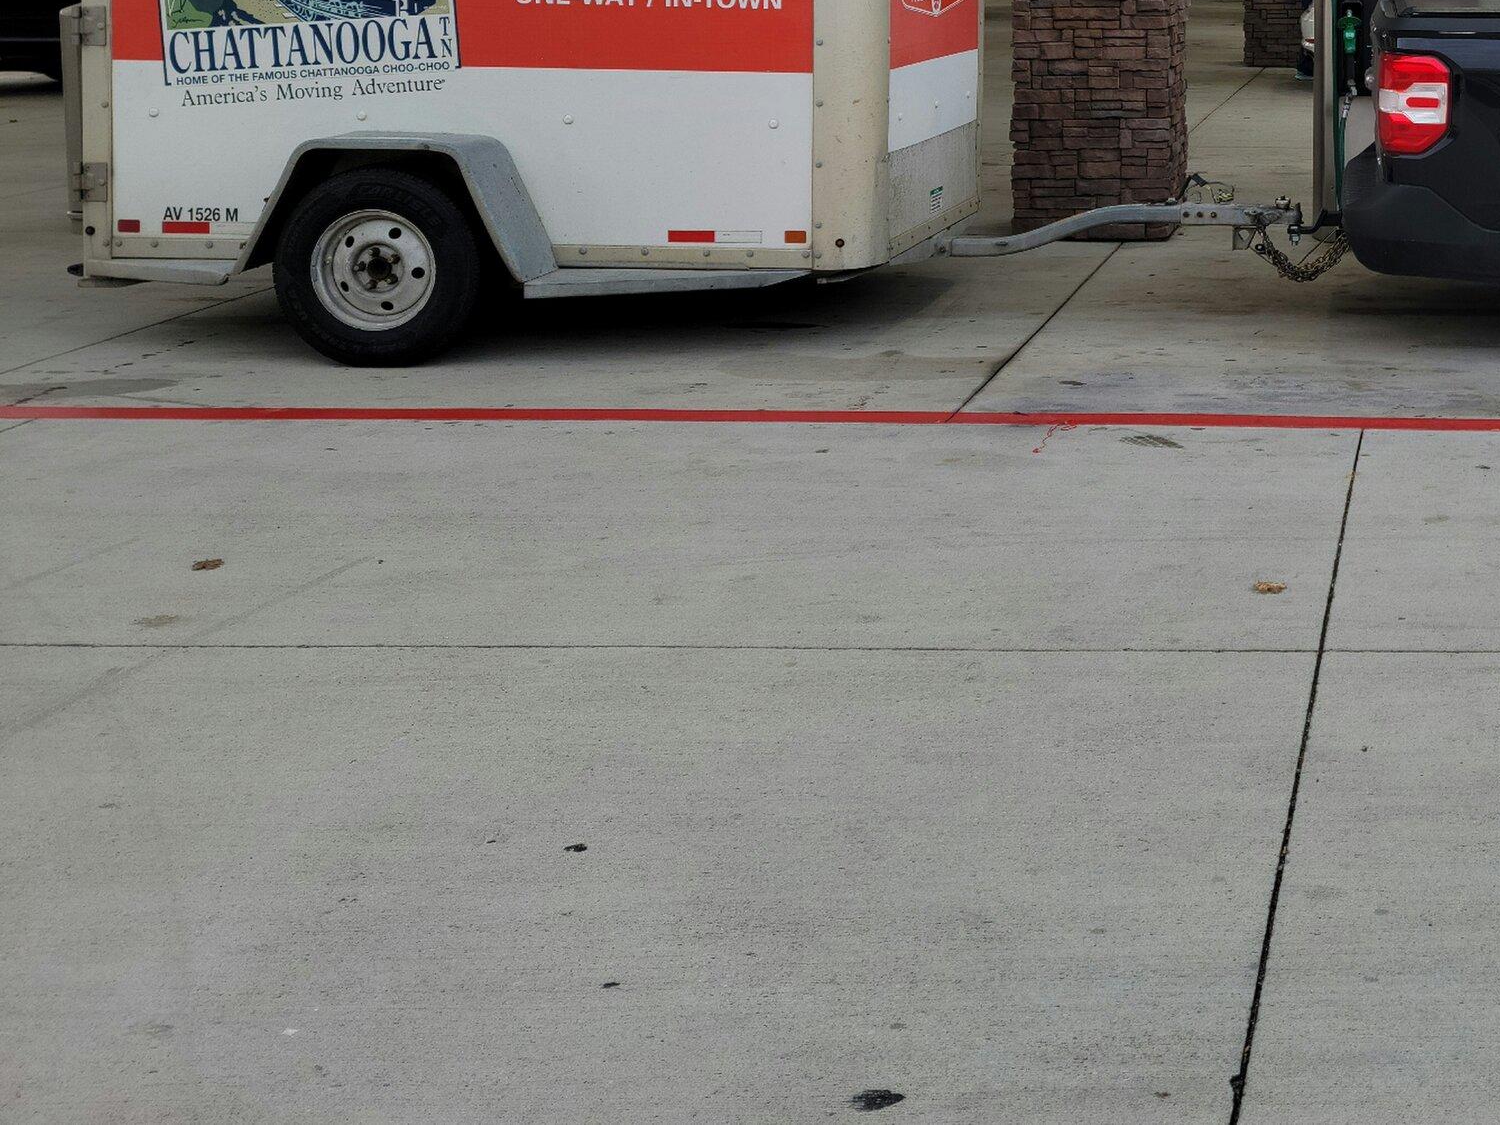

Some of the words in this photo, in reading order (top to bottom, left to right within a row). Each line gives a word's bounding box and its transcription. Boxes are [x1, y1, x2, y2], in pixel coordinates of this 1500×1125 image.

[169, 17, 438, 74] CHATTANOOGA
[176, 75, 209, 86] HOME
[211, 74, 226, 84] OF
[229, 72, 250, 82] THE
[251, 69, 297, 81] FAMOUS
[299, 66, 380, 78] CHATTANOOGA
[382, 61, 450, 73] CHOO-CHOO
[182, 85, 268, 107] America's
[276, 82, 343, 101] Moving
[163, 206, 183, 221] AV
[187, 207, 221, 222] 1526
[225, 207, 239, 222] M
